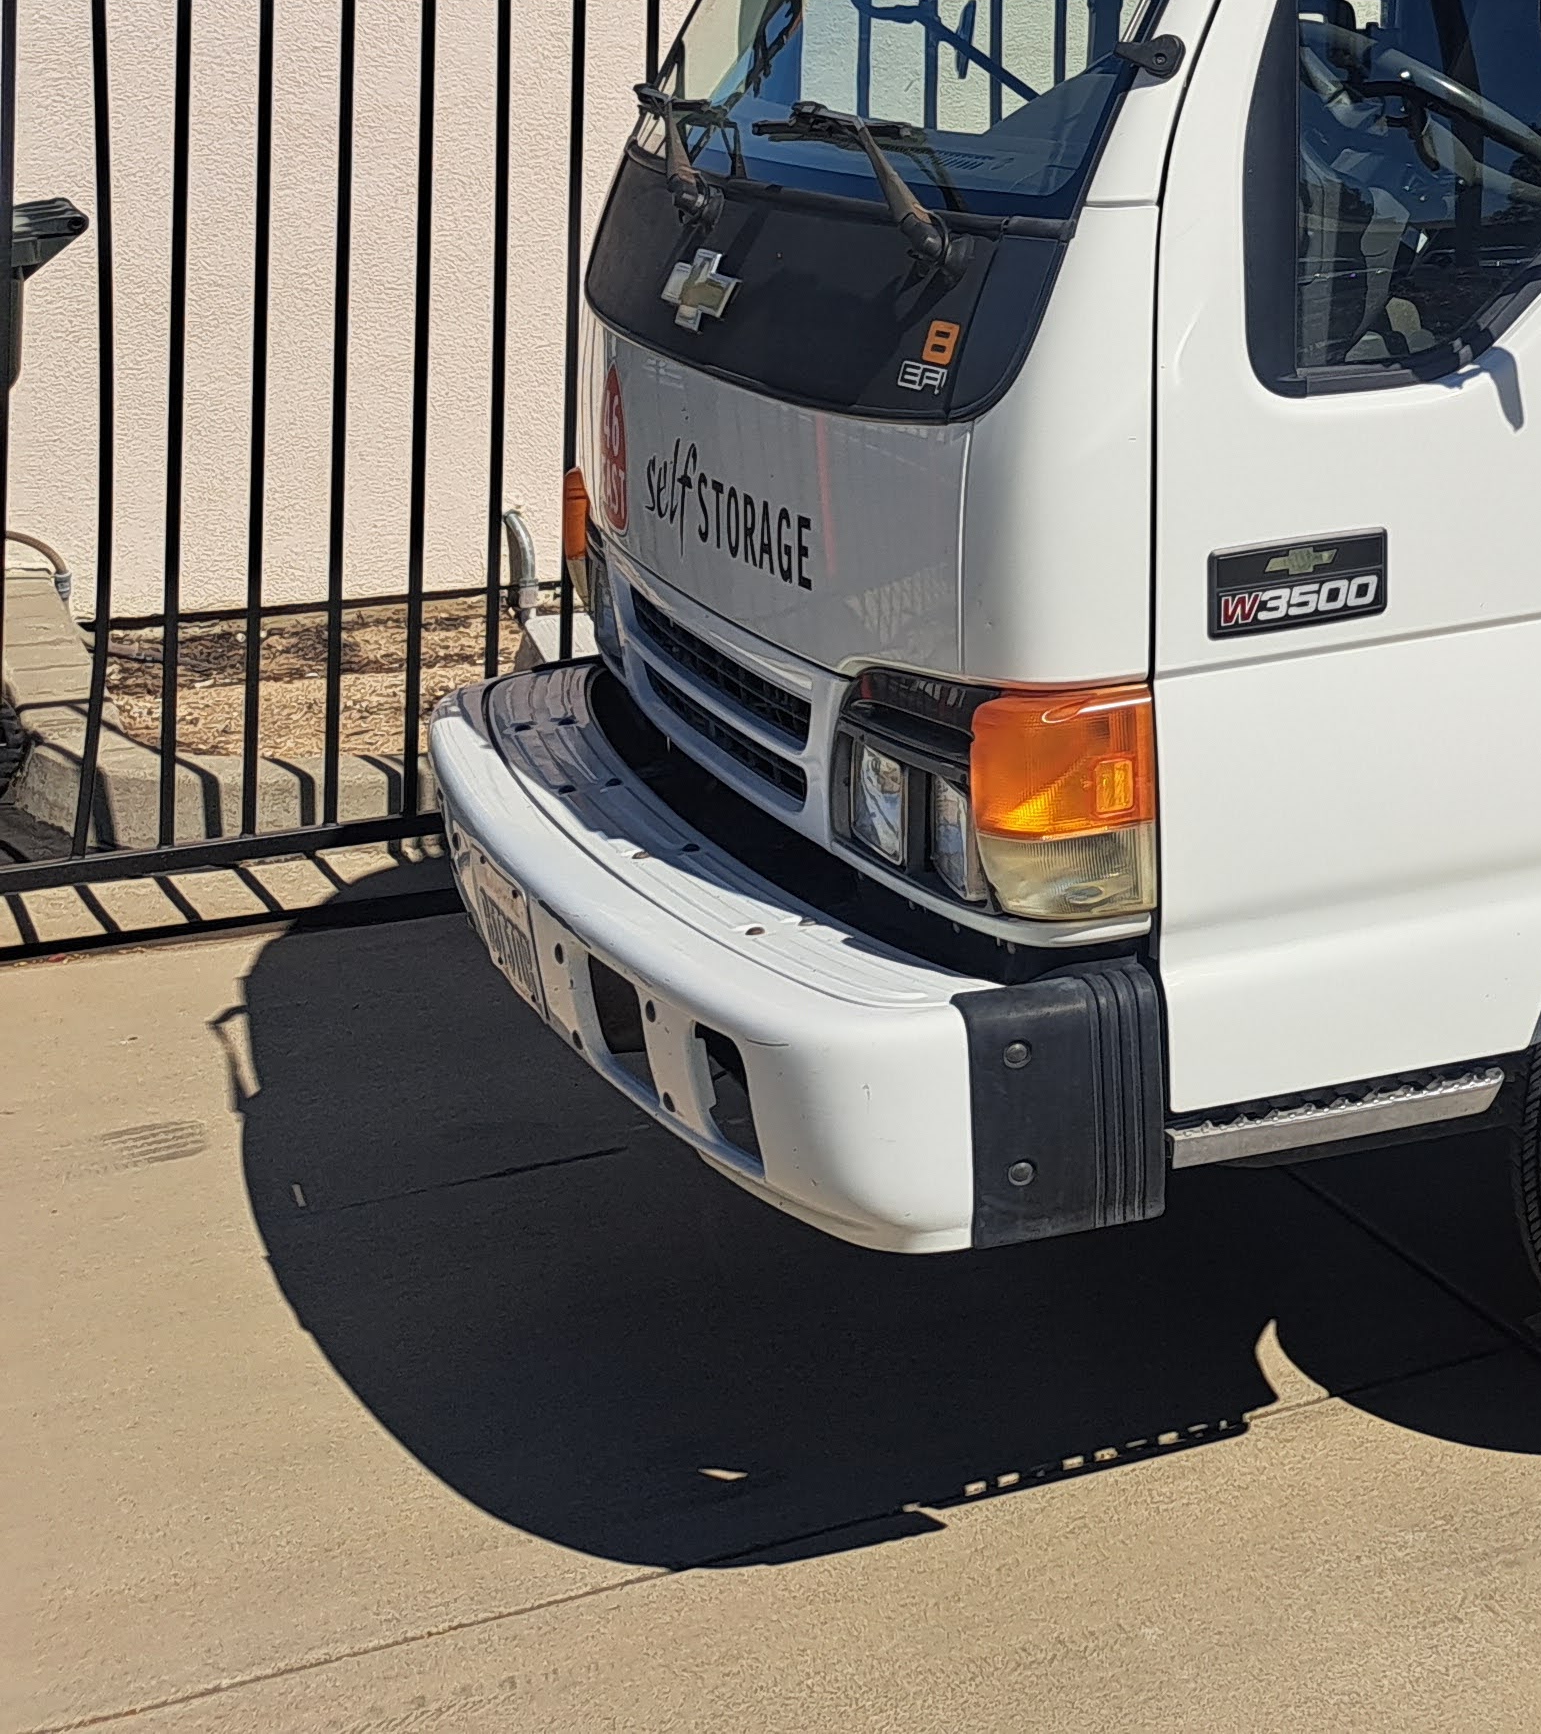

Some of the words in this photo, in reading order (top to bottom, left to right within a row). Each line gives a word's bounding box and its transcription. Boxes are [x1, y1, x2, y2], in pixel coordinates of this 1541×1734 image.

[604, 389, 620, 457] 46
[645, 438, 698, 557] self
[698, 472, 813, 592] STORAGE
[1220, 574, 1378, 627] W3500
